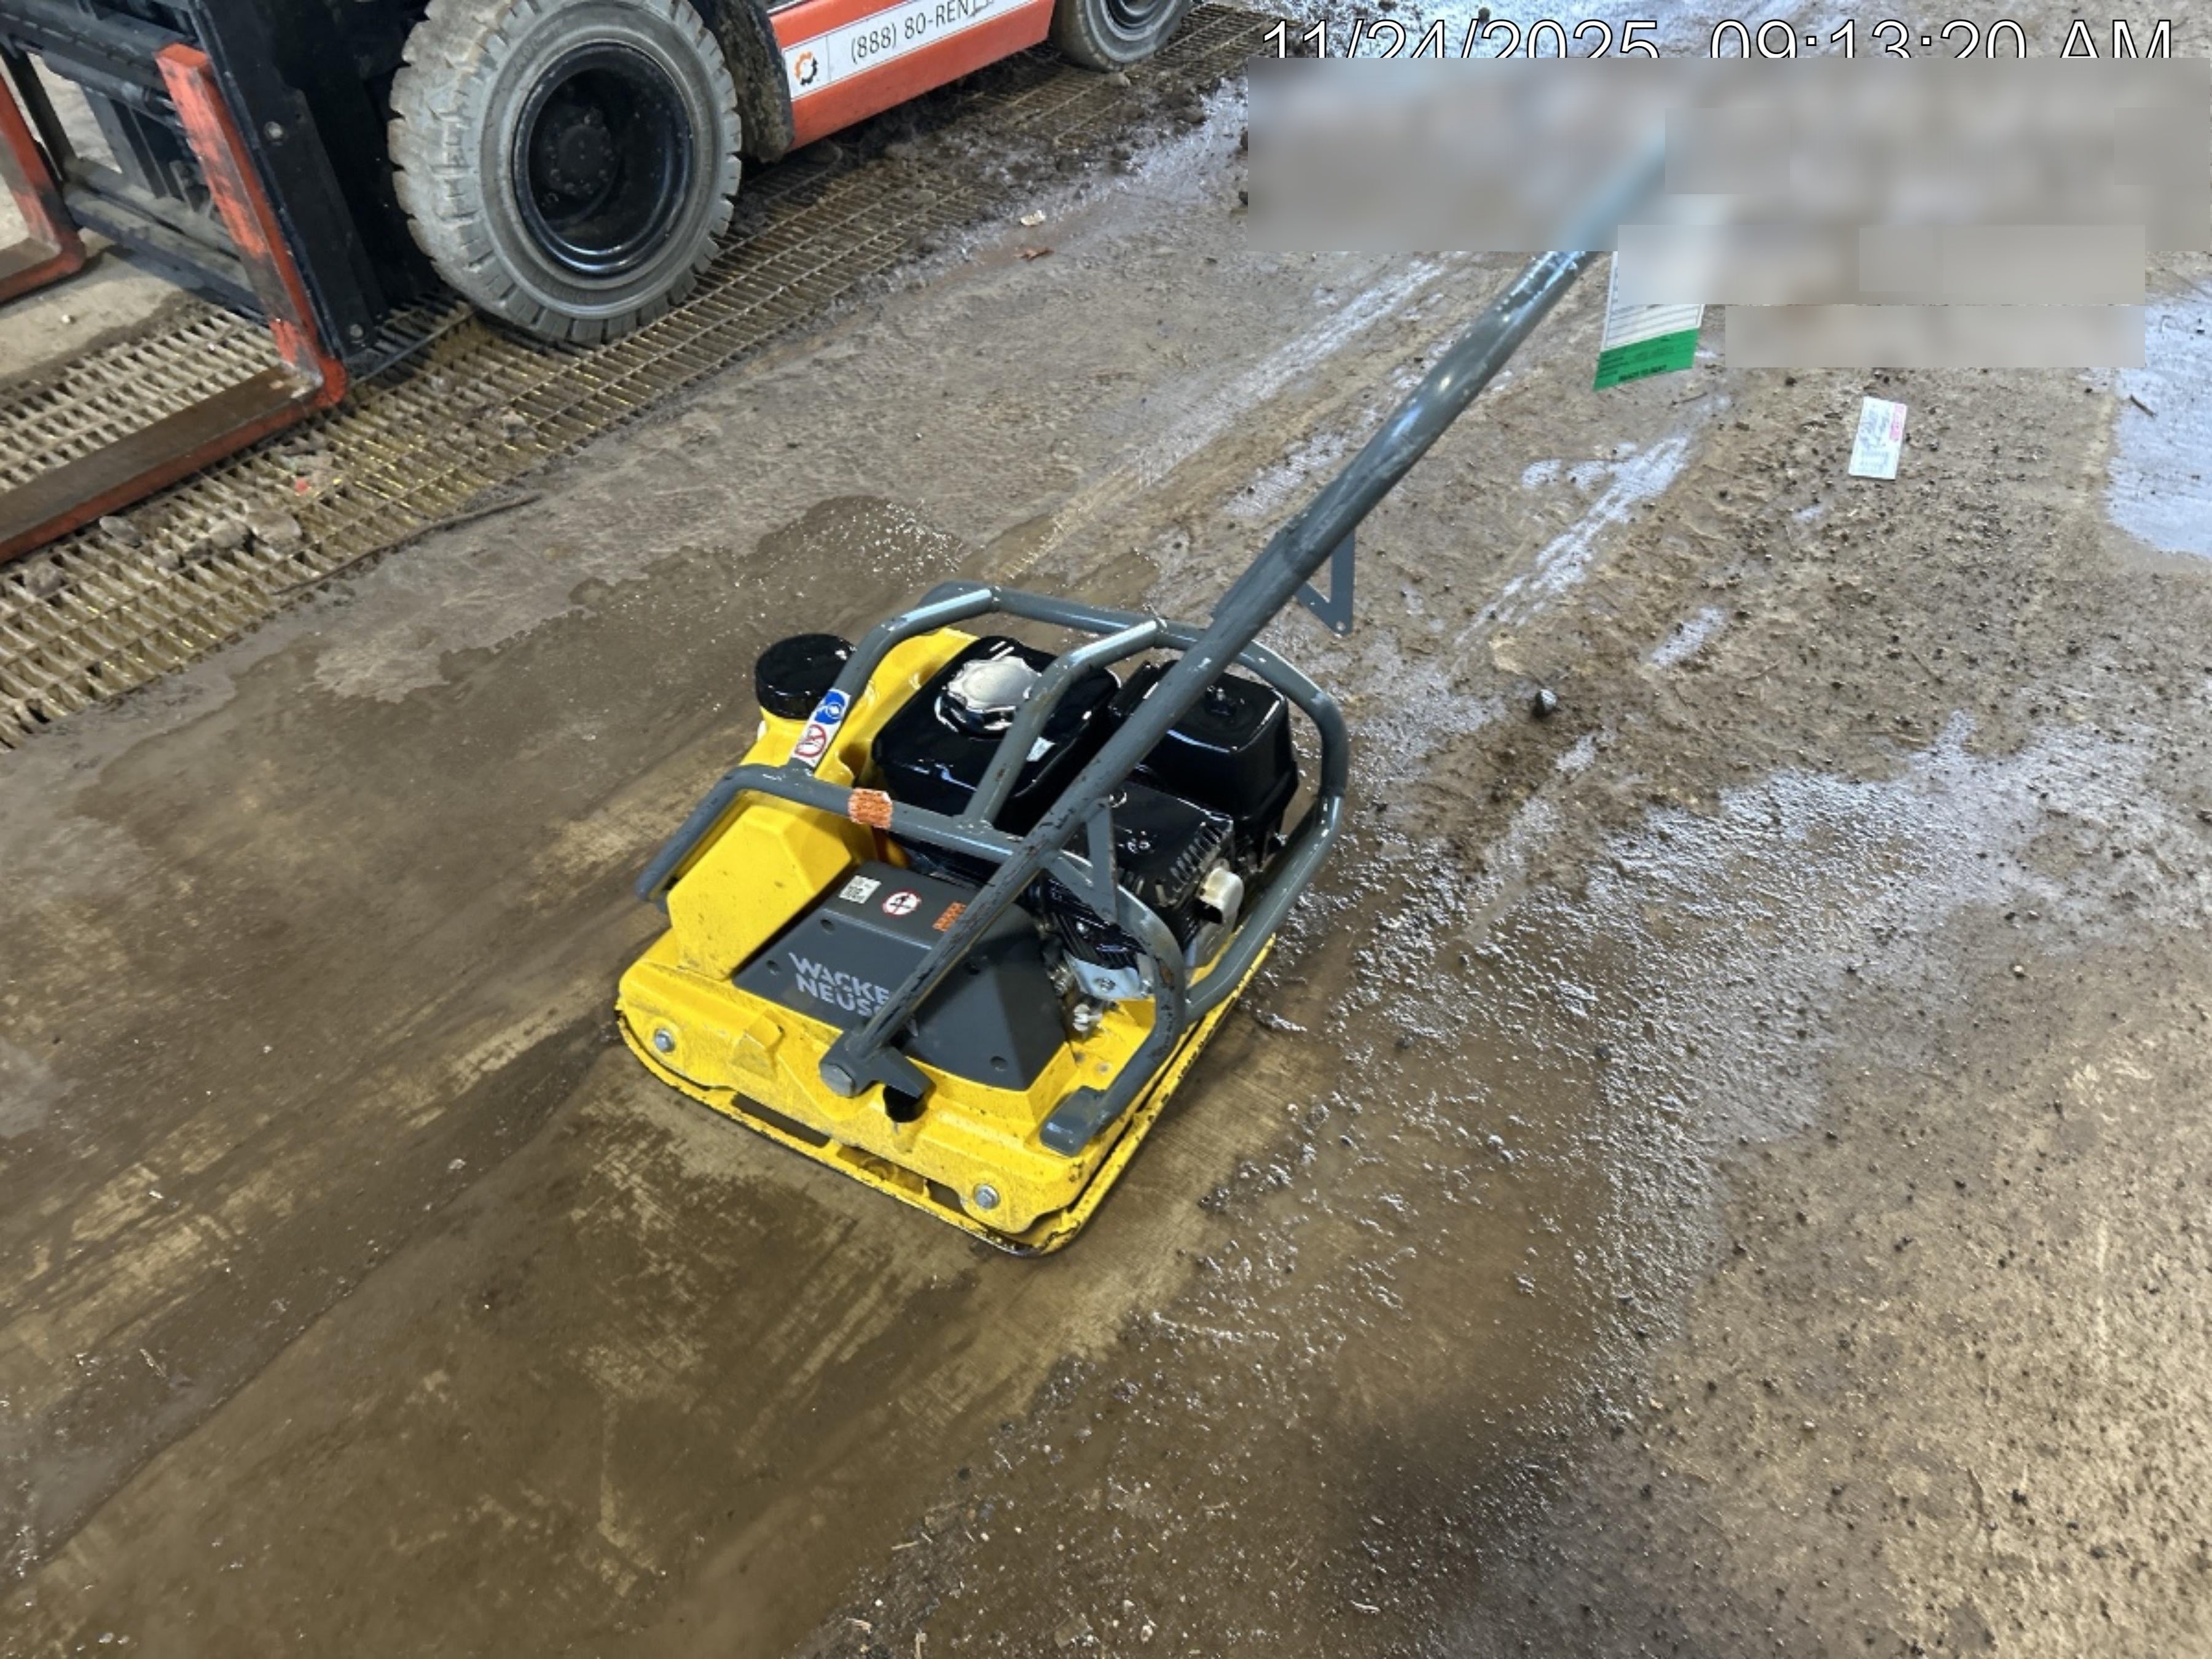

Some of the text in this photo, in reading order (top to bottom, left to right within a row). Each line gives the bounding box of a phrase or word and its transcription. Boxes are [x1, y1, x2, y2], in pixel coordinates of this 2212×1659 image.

[851, 22, 896, 64] (888)
[788, 952, 890, 1005] WACKE
[796, 973, 884, 1018] NEUS
